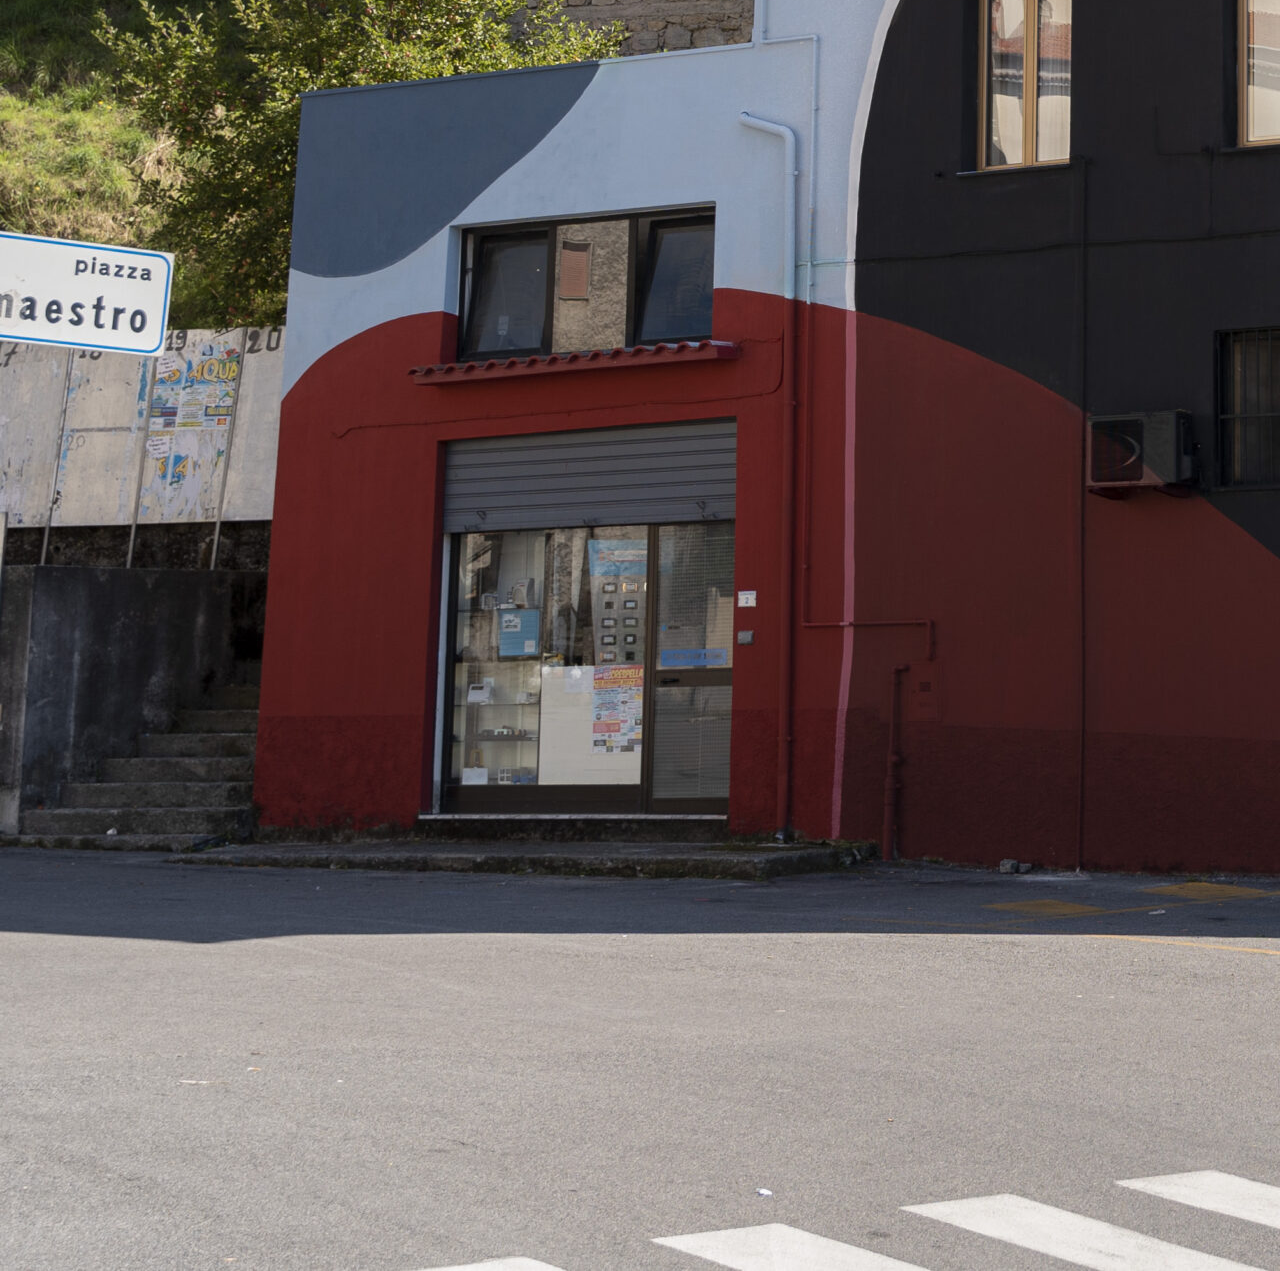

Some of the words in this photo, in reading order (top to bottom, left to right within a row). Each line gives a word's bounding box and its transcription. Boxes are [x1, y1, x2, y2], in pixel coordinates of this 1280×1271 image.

[74, 256, 152, 281] piazza
[166, 329, 188, 351] 19
[246, 328, 282, 354] 20
